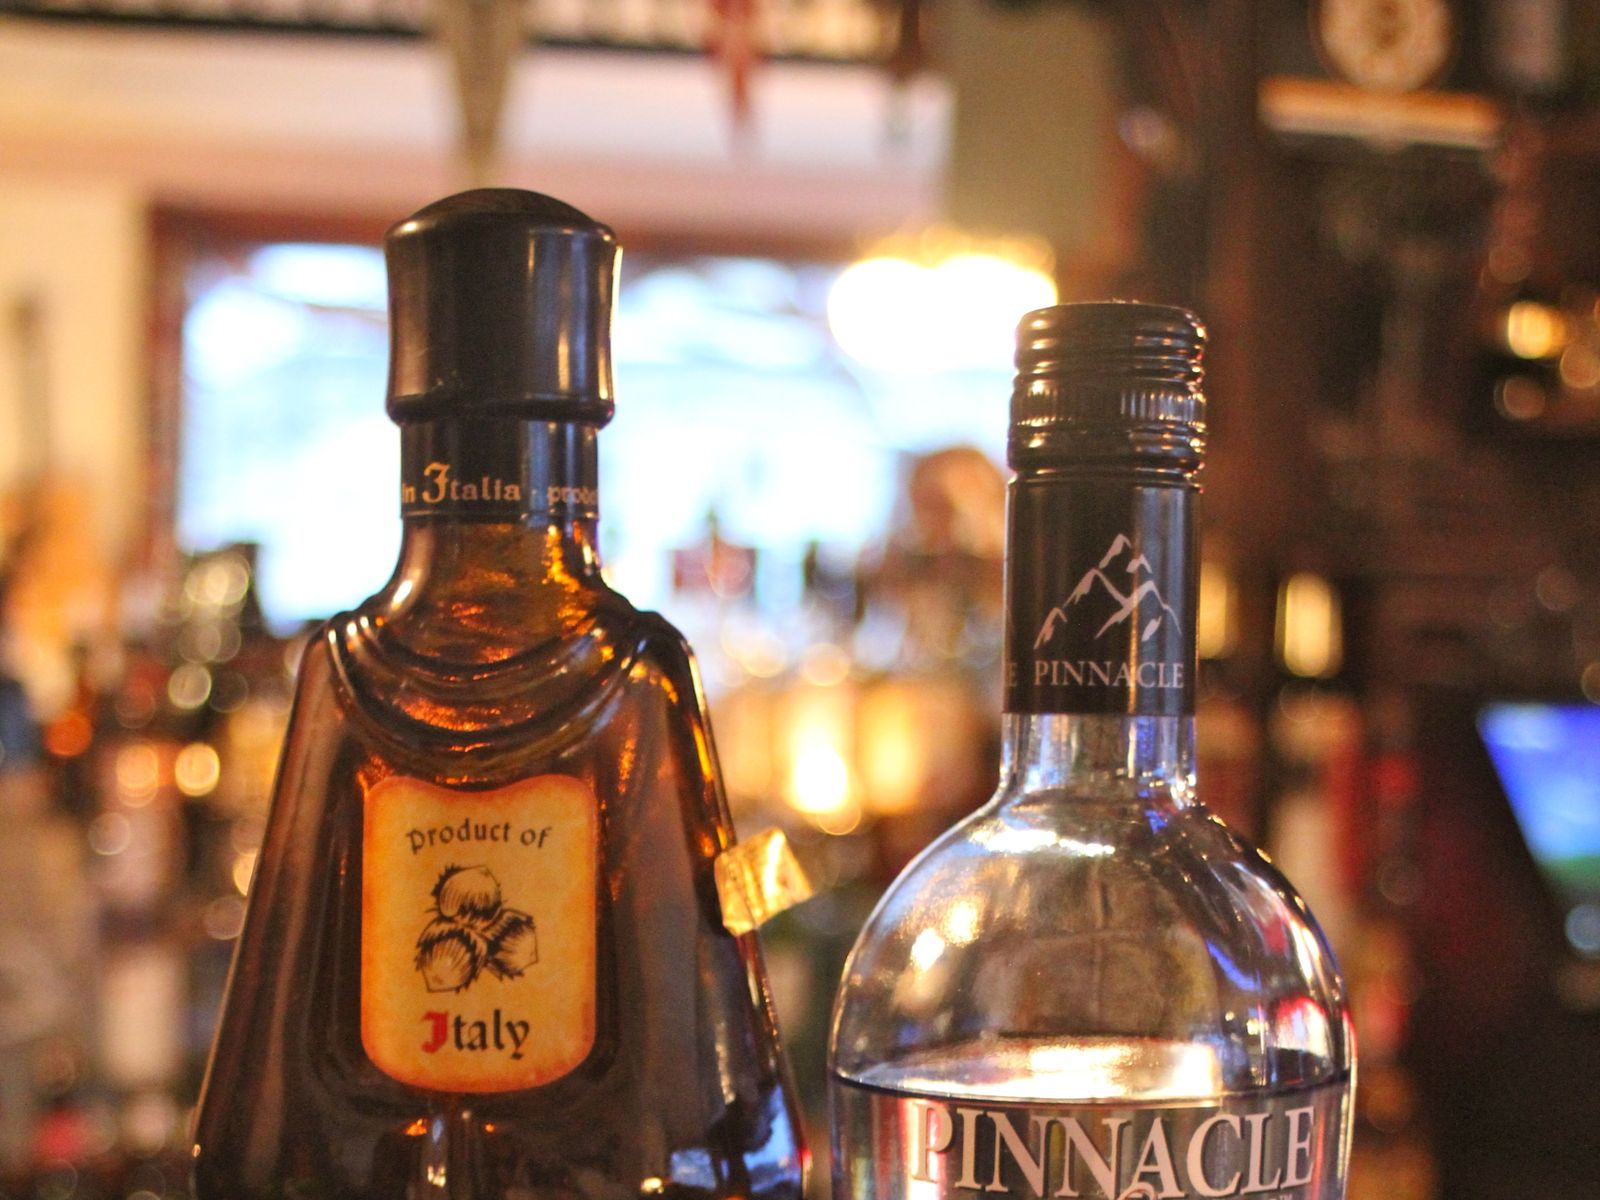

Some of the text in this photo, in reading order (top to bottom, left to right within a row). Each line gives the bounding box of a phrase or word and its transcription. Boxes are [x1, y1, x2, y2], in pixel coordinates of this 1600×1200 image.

[422, 461, 521, 504] Italia
[1034, 659, 1185, 688] PINNACLE
[406, 817, 553, 855] product of
[421, 1008, 530, 1060] Italy
[909, 1100, 1316, 1200] PINNACLE
